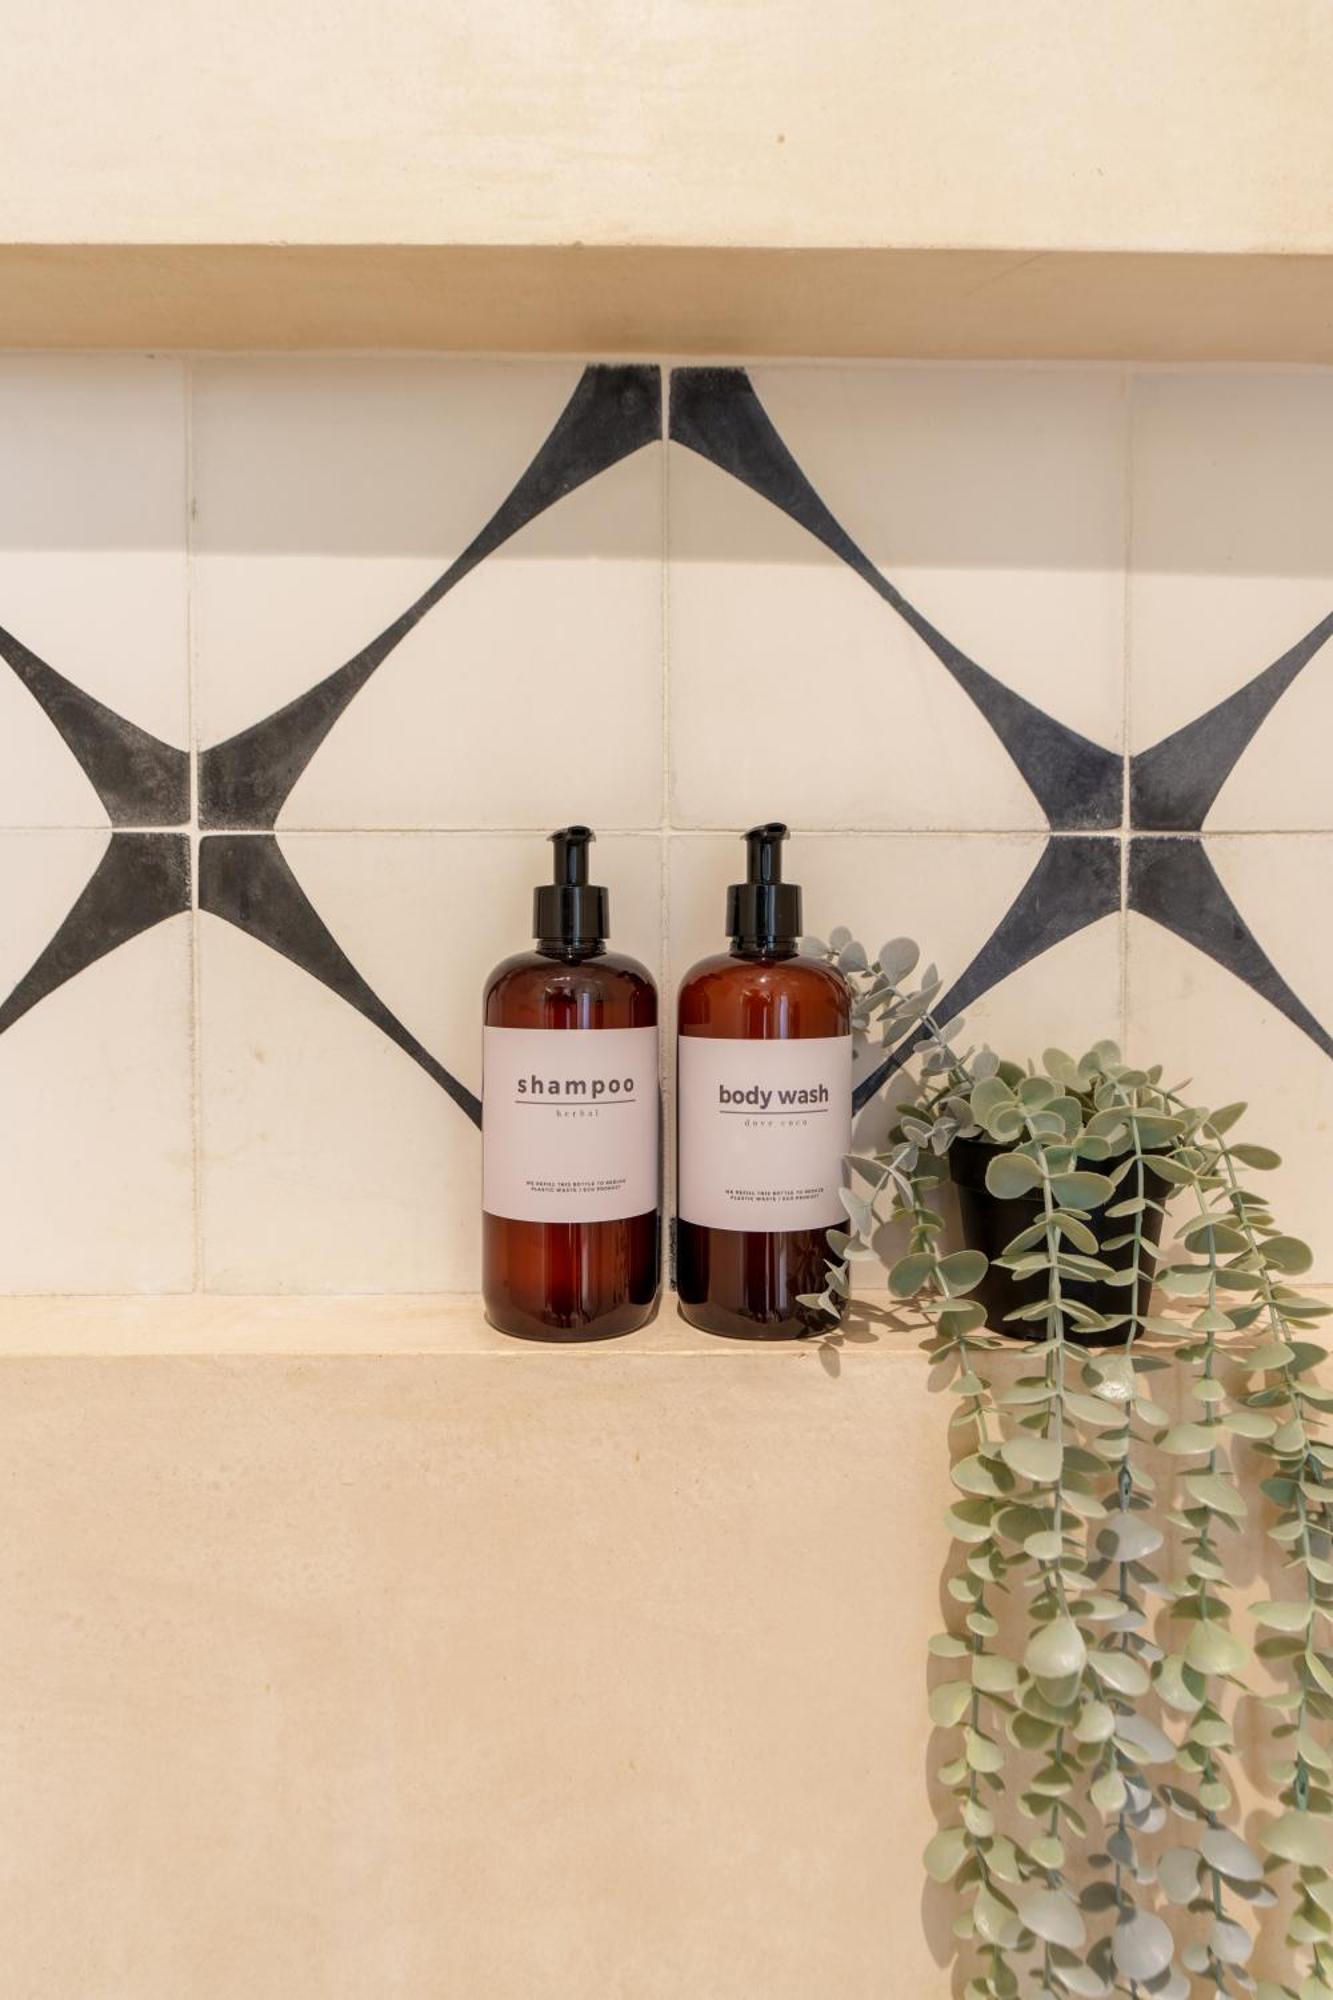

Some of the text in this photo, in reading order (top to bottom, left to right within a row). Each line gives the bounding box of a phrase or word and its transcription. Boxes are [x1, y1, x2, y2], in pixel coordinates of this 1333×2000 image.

[517, 1074, 634, 1099] shampoo
[719, 1083, 829, 1109] body wash
[555, 1109, 599, 1118] herbal
